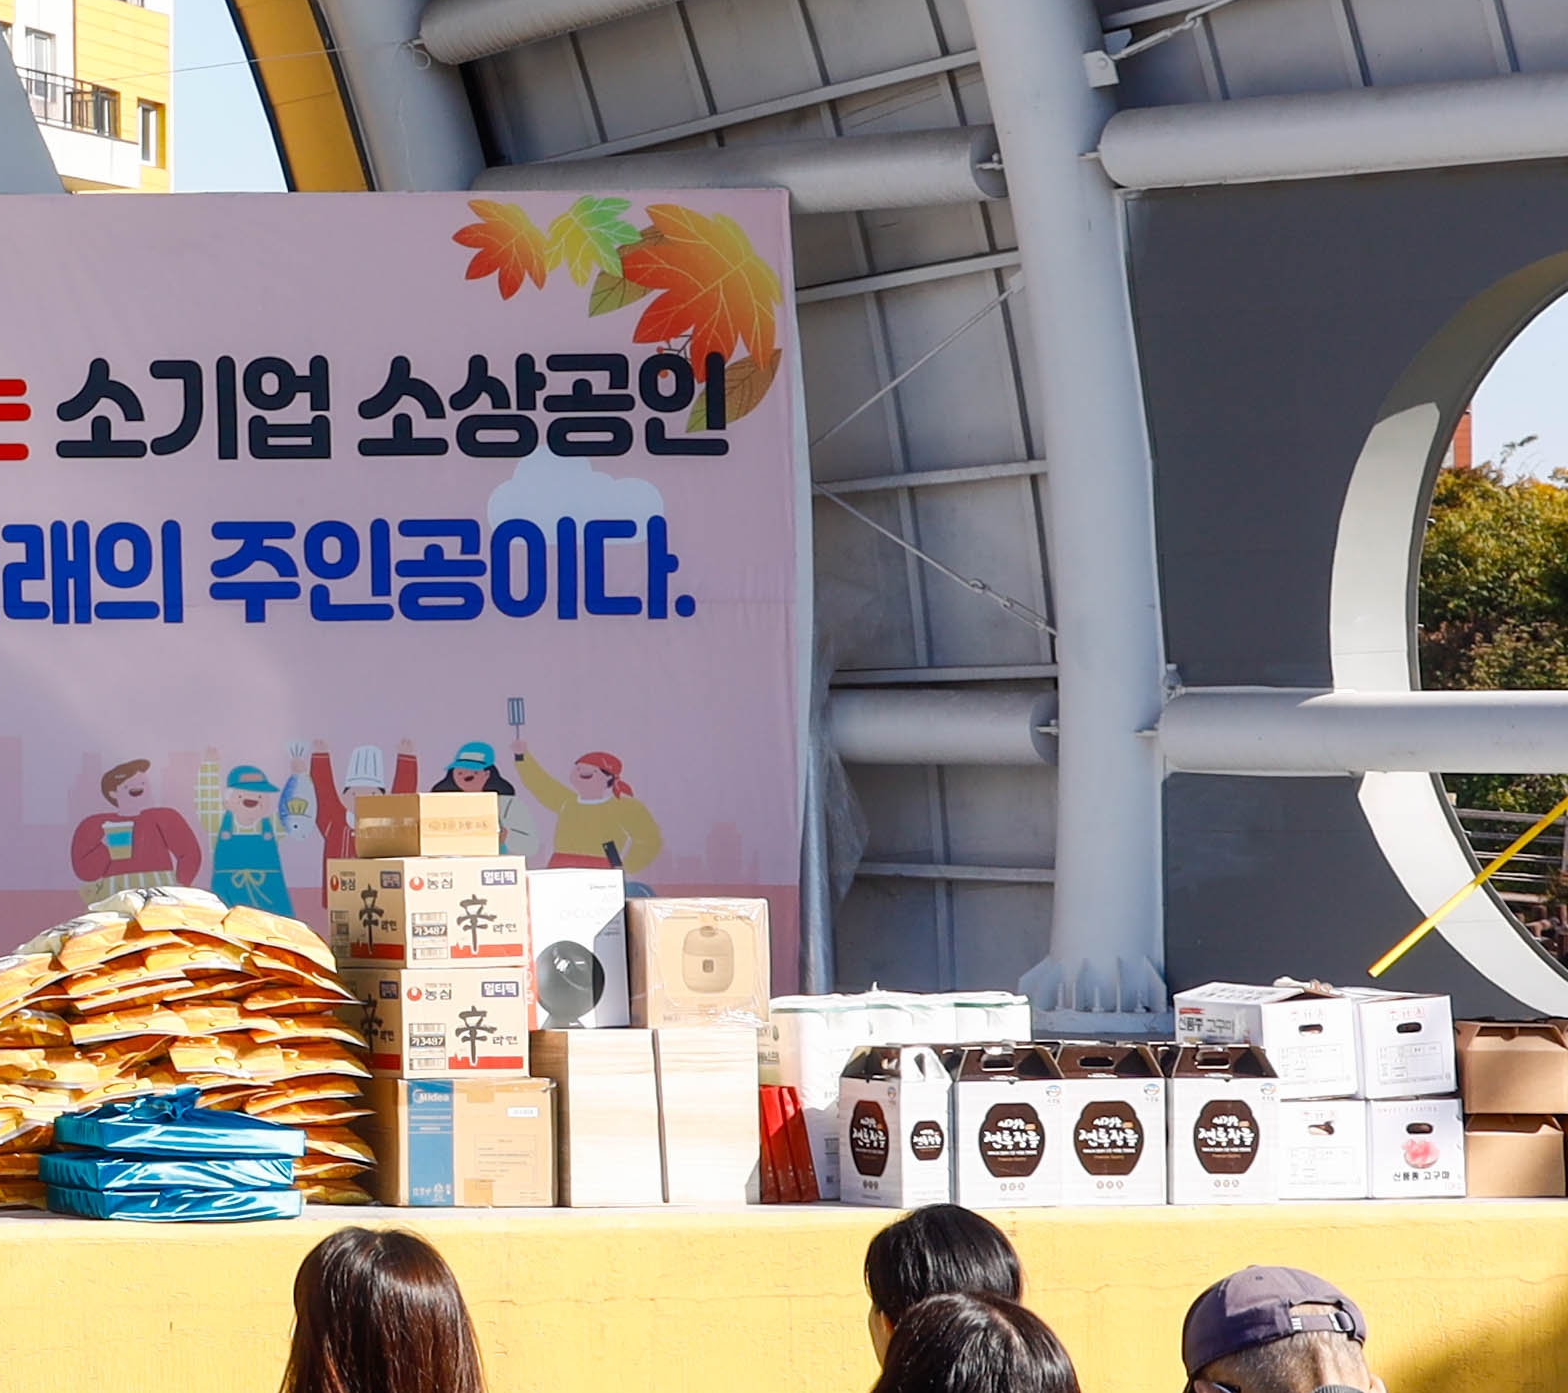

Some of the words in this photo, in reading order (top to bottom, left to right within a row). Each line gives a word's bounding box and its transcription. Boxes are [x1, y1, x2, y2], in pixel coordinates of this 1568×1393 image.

[56, 355, 332, 461] 소기업
[357, 351, 730, 459] 소상공인
[209, 514, 696, 623] 주인공이다.
[426, 878, 454, 891] 농심
[482, 870, 517, 885] 멀티팩
[424, 989, 453, 1001] 농심
[482, 982, 518, 996] 멀티팩
